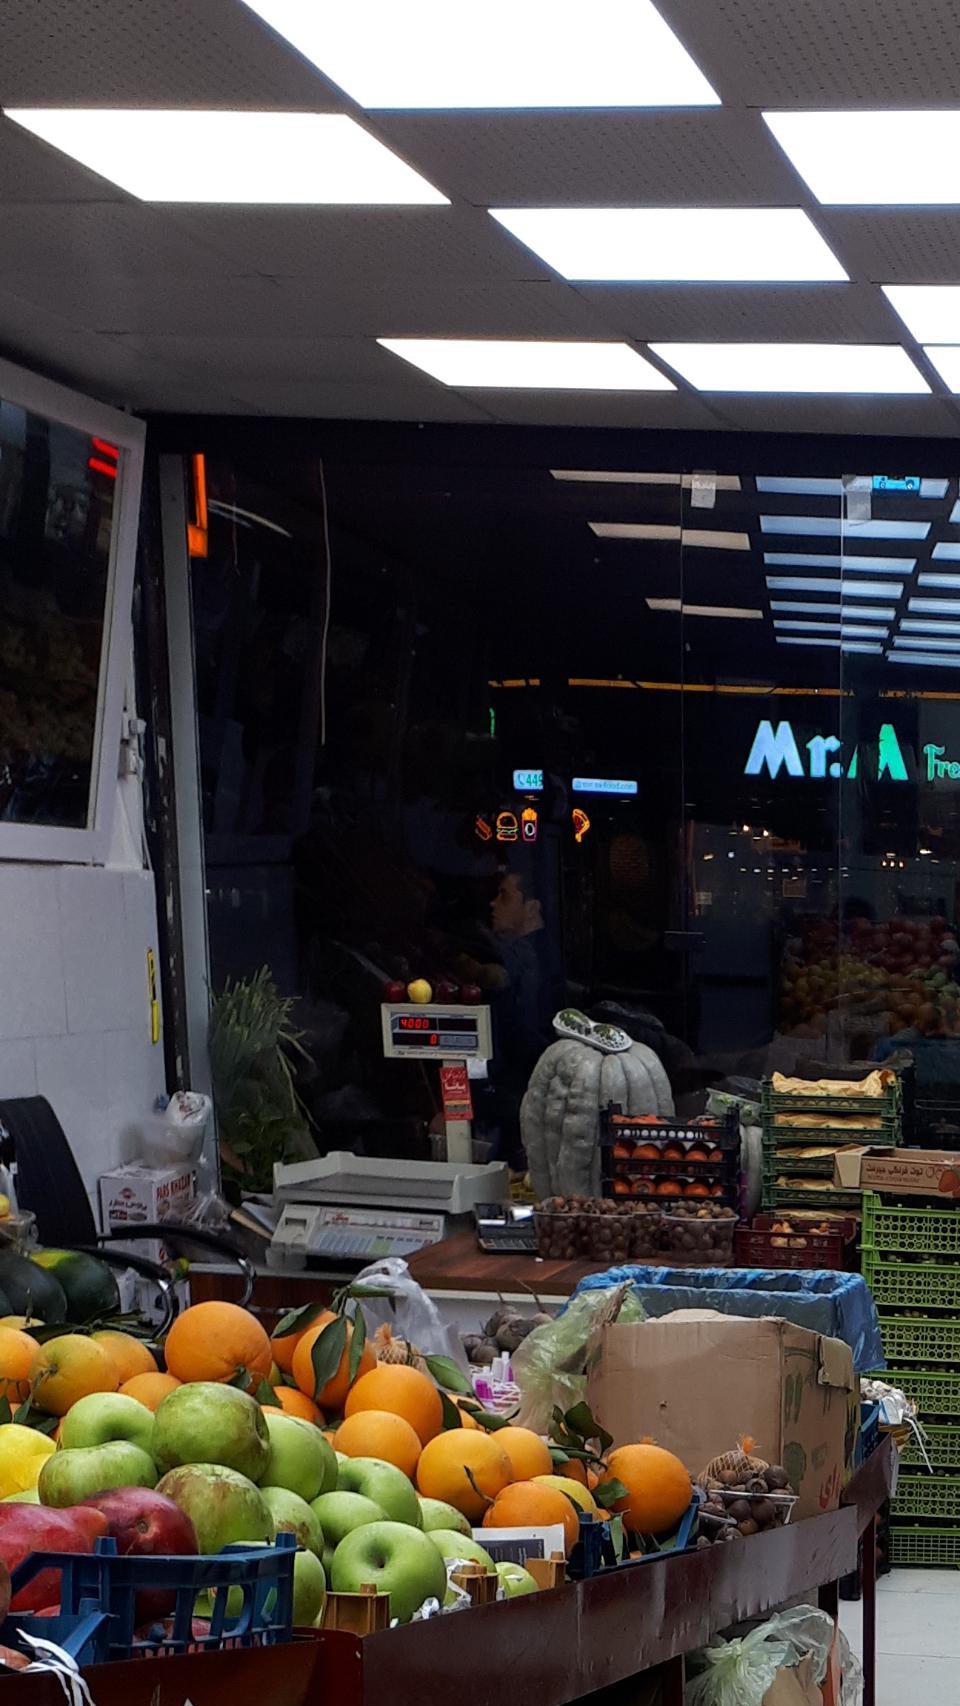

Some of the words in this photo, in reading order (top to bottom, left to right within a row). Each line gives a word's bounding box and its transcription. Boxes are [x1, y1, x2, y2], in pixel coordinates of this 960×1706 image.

[744, 720, 843, 779] Mr.
[400, 1018, 430, 1030] 4000
[430, 1033, 438, 1046] 0
